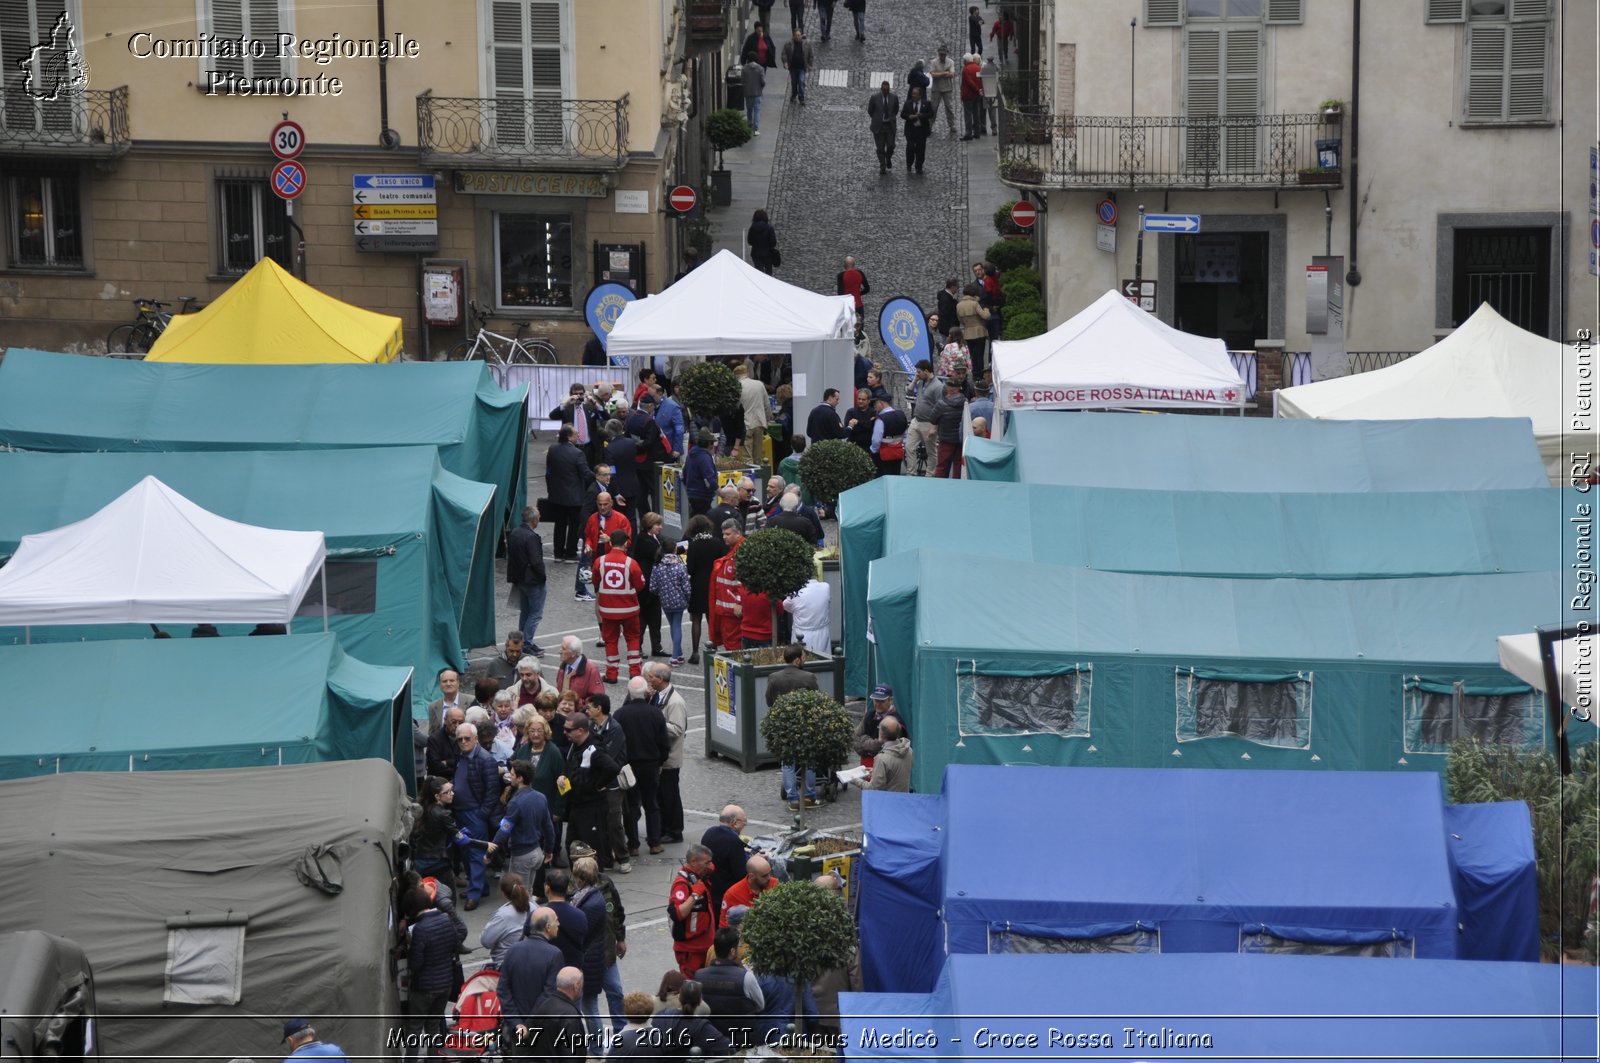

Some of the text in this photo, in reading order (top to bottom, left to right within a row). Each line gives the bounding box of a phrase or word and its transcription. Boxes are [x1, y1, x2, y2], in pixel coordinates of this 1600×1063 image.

[278, 131, 298, 149] 30
[462, 173, 602, 195] PASTICCERIA
[379, 192, 399, 200] teatro
[1032, 387, 1217, 403] CROCE ROSSA ITALIANA
